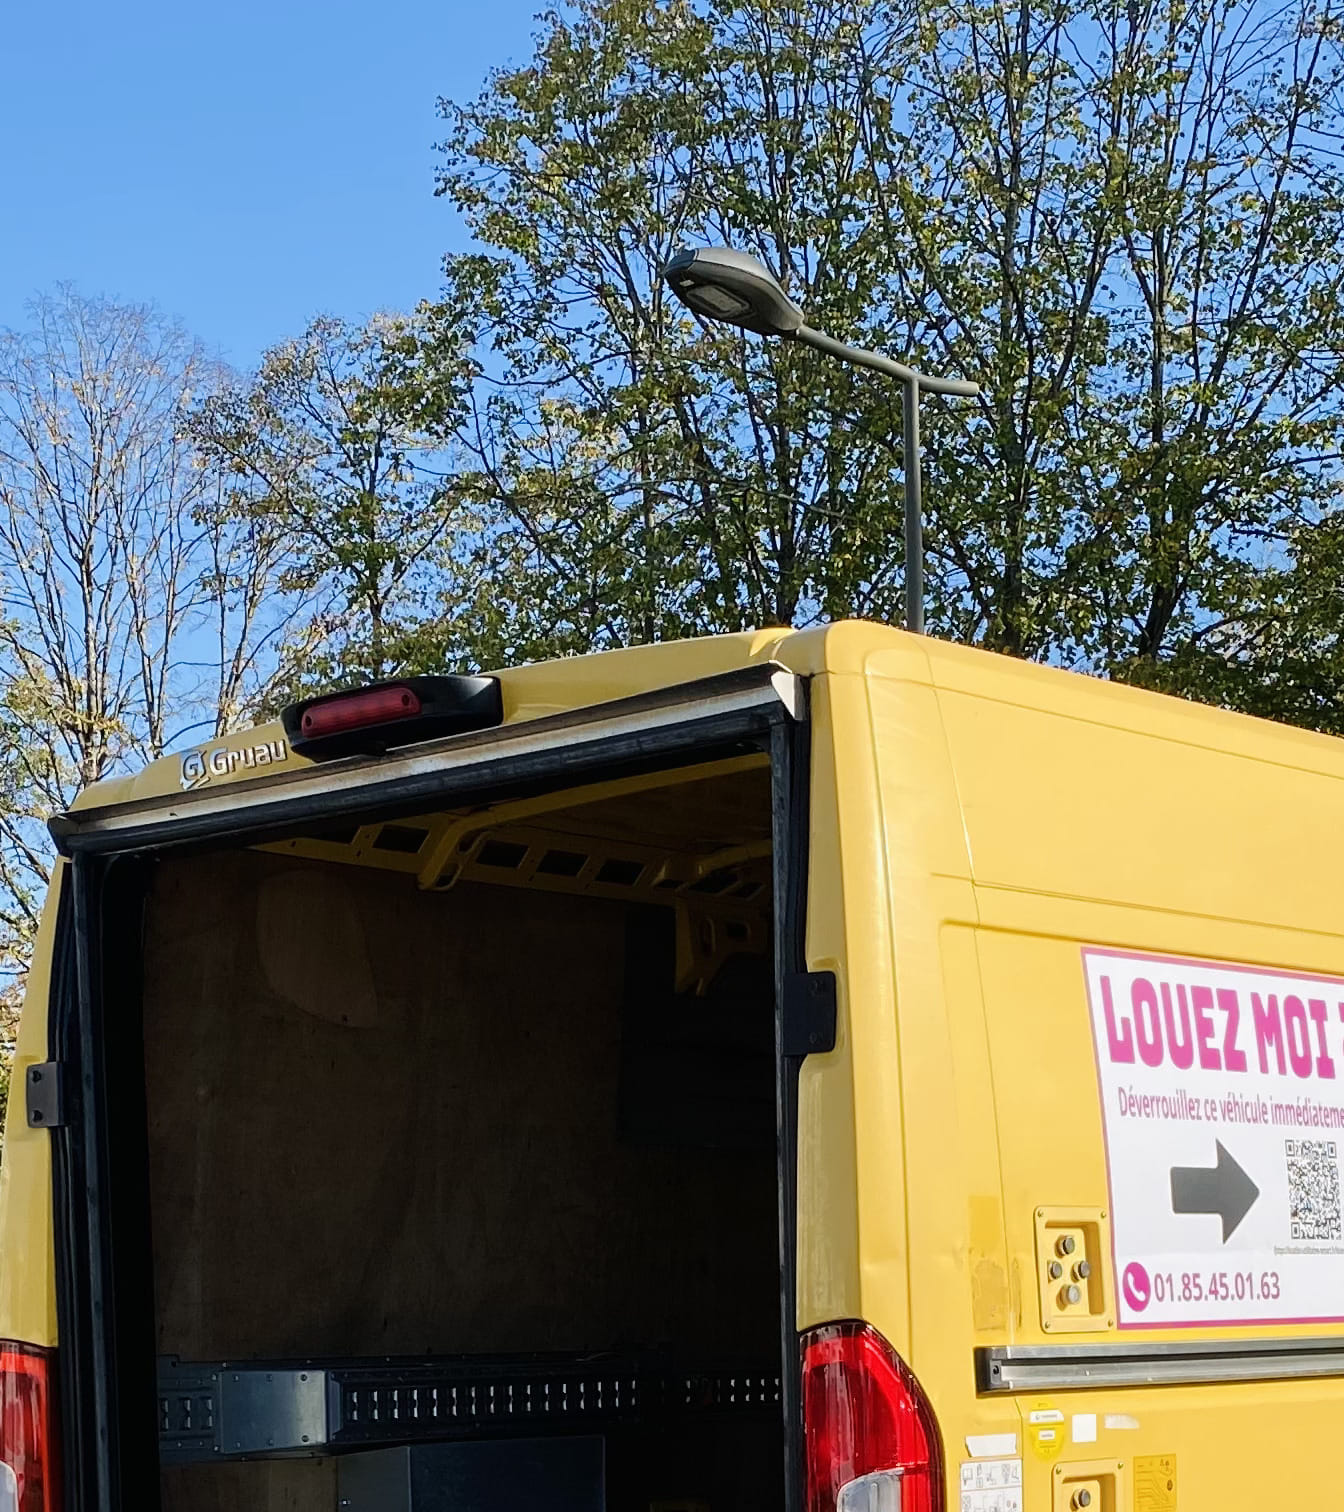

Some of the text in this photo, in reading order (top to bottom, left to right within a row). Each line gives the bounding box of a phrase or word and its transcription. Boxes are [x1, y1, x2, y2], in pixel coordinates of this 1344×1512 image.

[209, 739, 288, 776] Gruau
[1100, 975, 1247, 1073] LOUEZ
[1250, 991, 1336, 1080] MOI
[1118, 1085, 1202, 1120] Déverrouillez
[1204, 1098, 1218, 1122] ce
[1219, 1091, 1268, 1124] véhicule
[1154, 1272, 1281, 1302] 01.85.45.01.63
